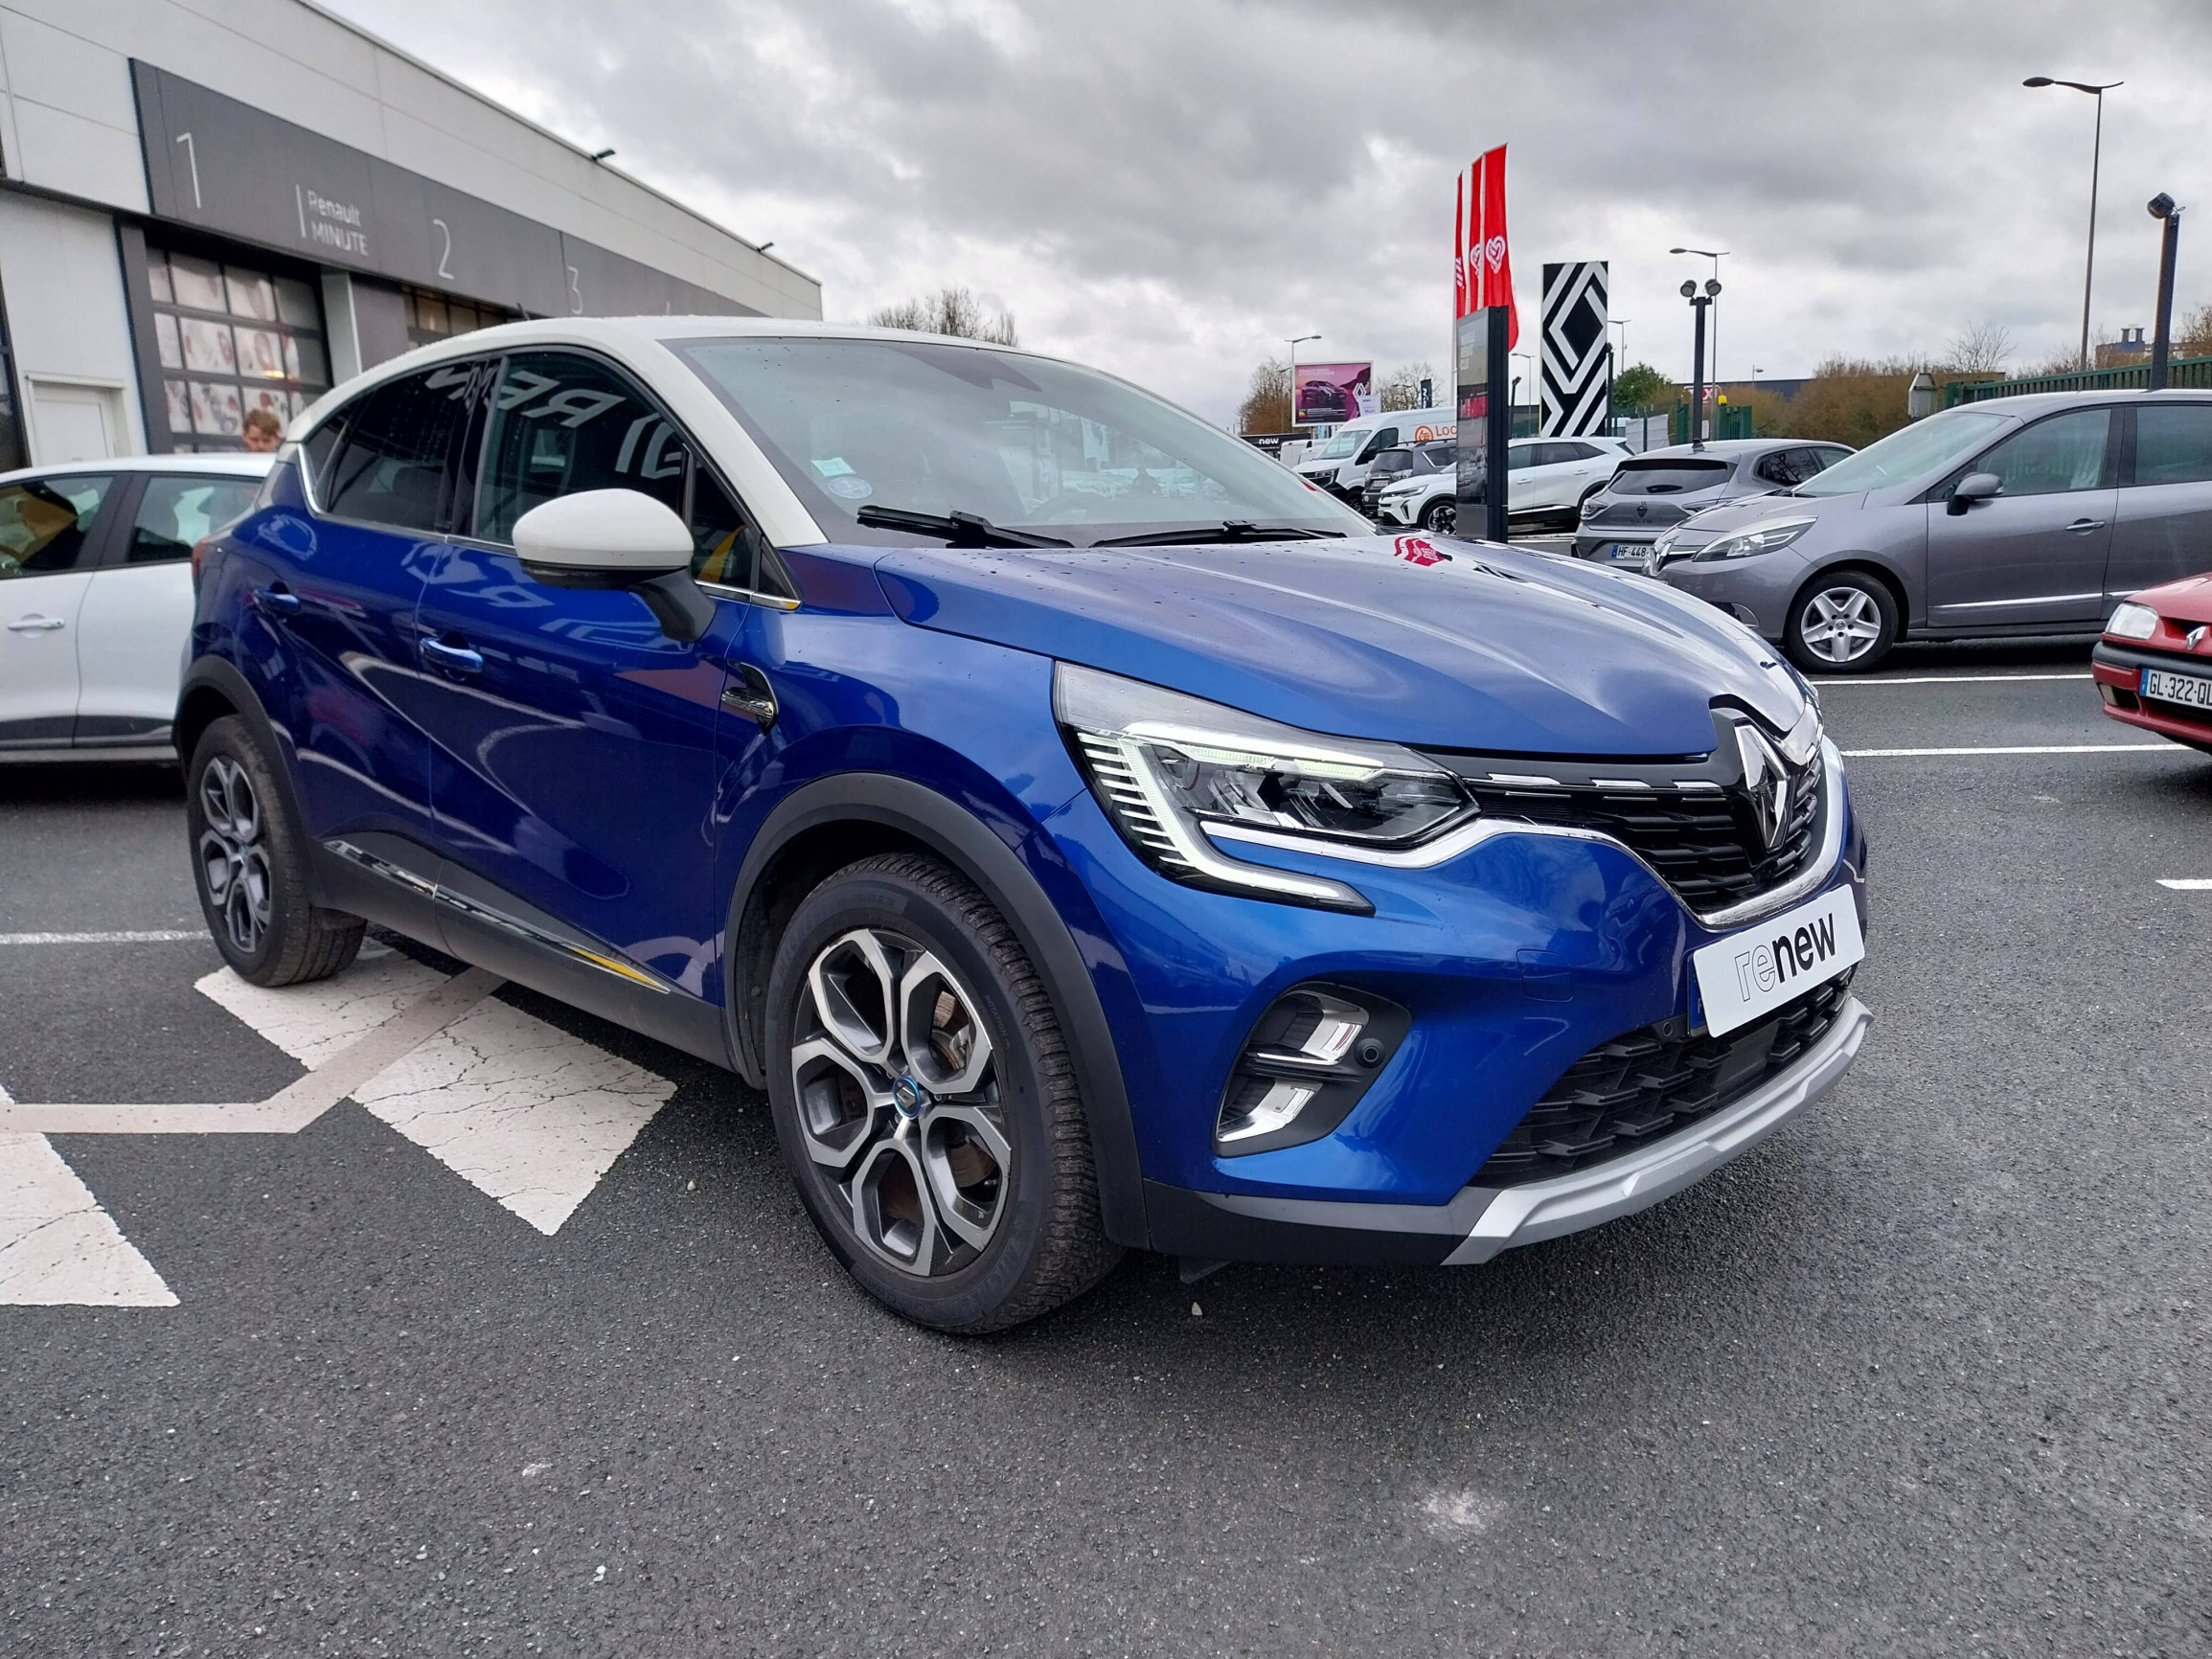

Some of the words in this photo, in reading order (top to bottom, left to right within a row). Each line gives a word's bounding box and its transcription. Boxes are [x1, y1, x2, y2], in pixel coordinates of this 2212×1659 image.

[176, 132, 201, 209] 1
[307, 190, 362, 227] Renault
[311, 220, 368, 256] MINUTE
[433, 218, 455, 280] 2
[567, 265, 583, 315] 3
[1734, 913, 1836, 1002] renew
